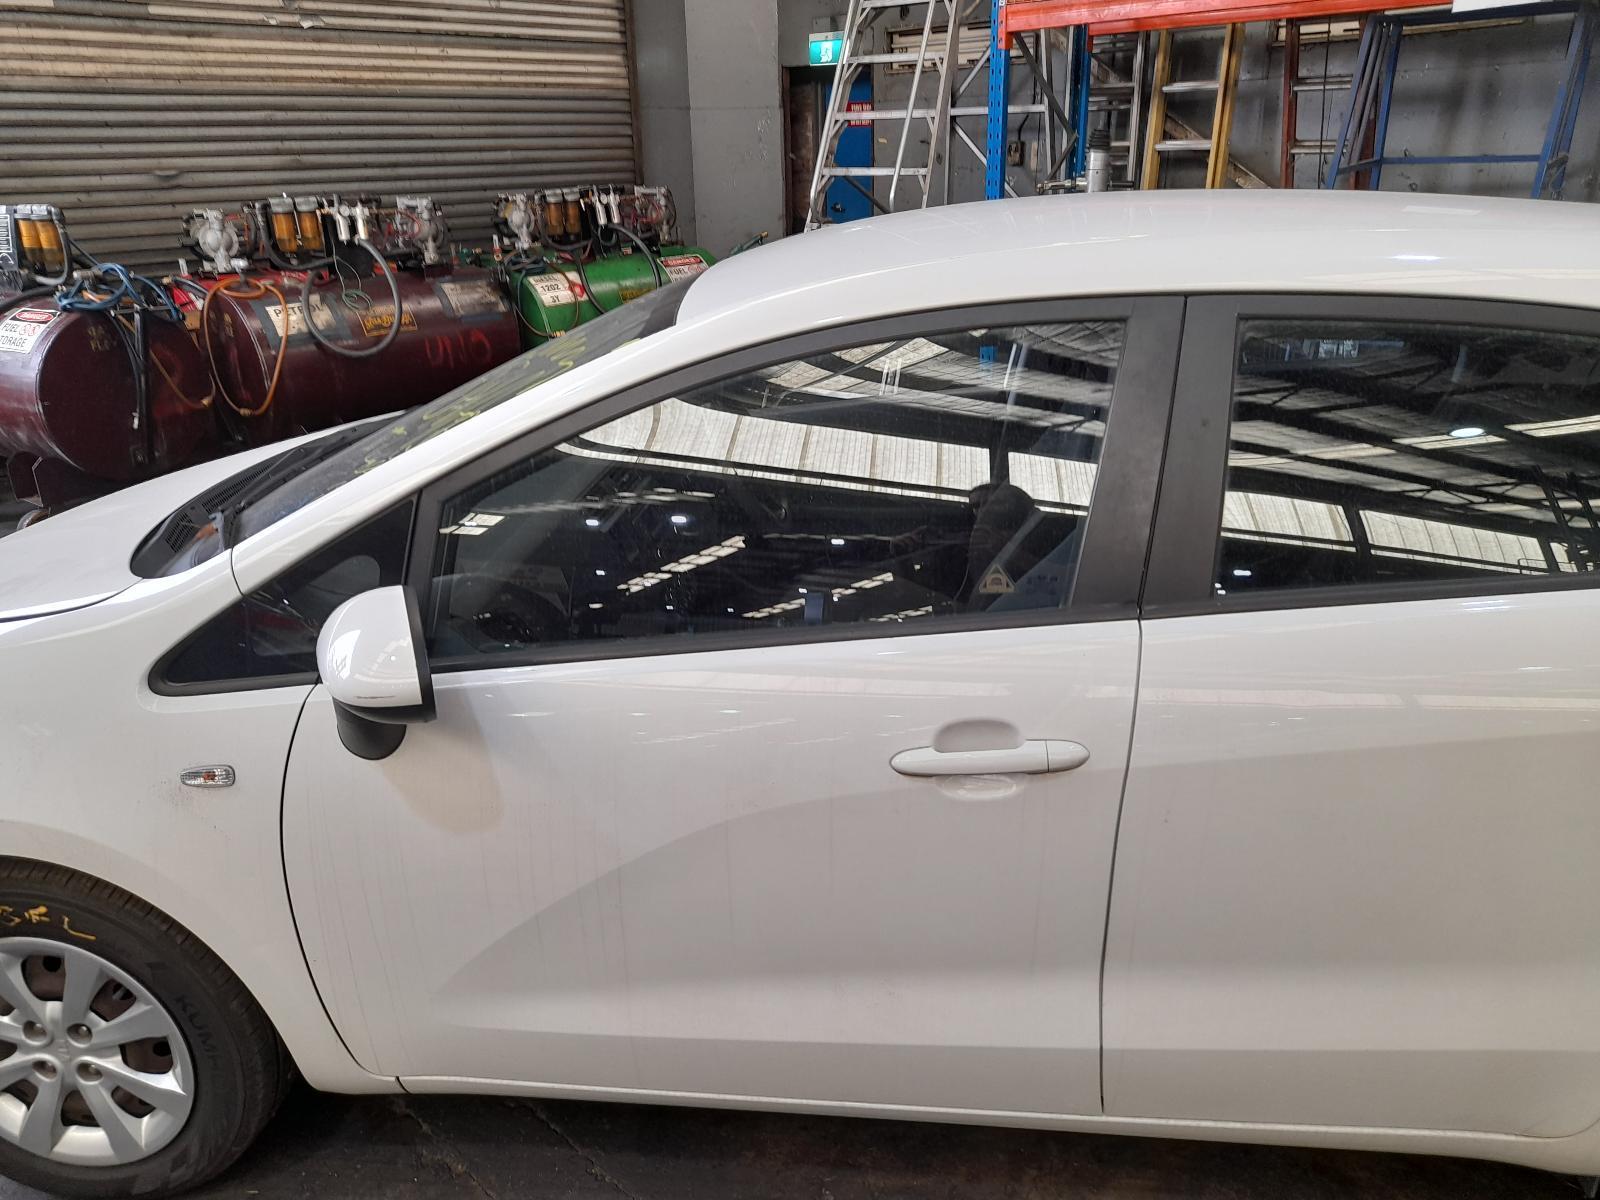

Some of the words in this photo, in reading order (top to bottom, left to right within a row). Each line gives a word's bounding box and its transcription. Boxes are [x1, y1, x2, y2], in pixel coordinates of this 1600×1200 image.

[540, 283, 561, 292] 1202
[2, 322, 19, 333] FUEL
[0, 335, 28, 347] TORAGE
